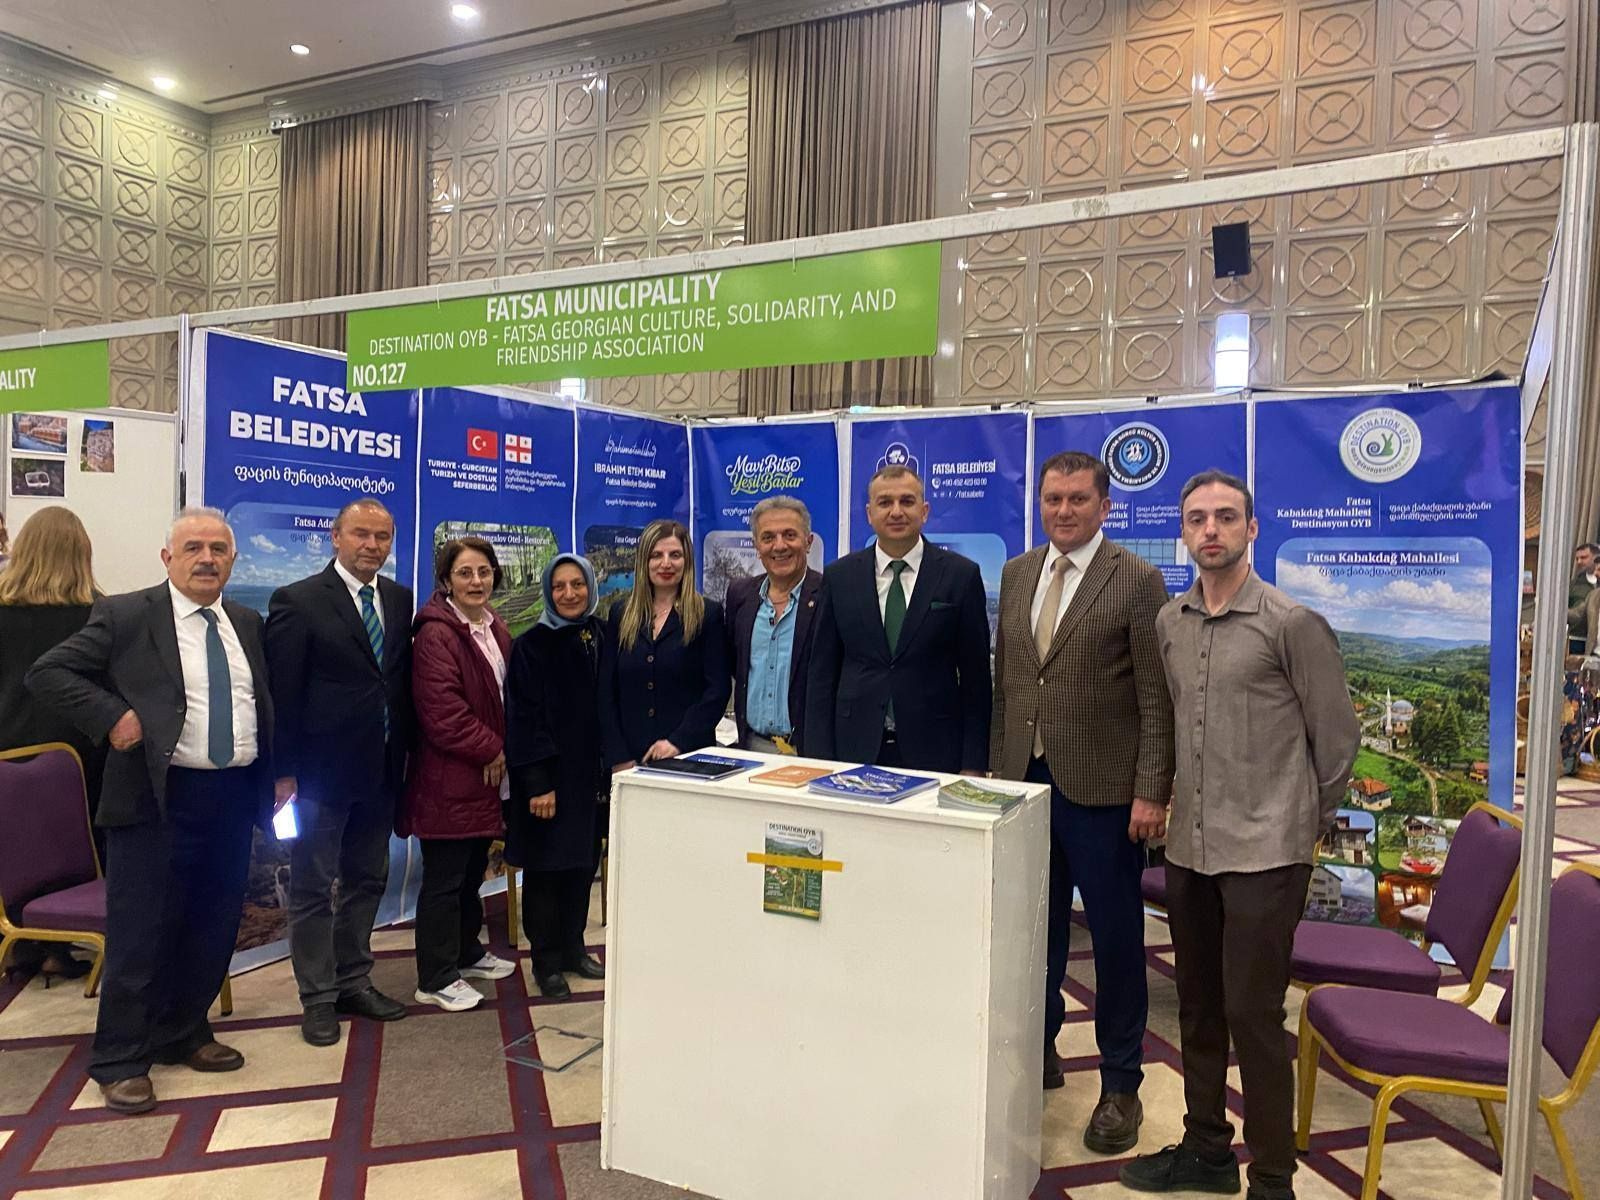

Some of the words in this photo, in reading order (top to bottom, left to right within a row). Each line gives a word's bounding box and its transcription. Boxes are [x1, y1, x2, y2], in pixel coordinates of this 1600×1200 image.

[486, 292, 548, 323] FATSA
[554, 272, 722, 316] MUNICIPALITY
[370, 332, 454, 356] DESTINATION
[459, 329, 487, 348] OYB
[503, 323, 546, 346] FATSA
[551, 316, 633, 341] GEORGIAN
[639, 307, 721, 333] CULTURE,
[727, 293, 844, 325] SOLIDARITY,
[850, 288, 897, 314] AND
[496, 342, 587, 367] FRIENDSHIP
[592, 333, 704, 360] ASSOCIATION
[352, 362, 407, 387] NO.127
[273, 376, 368, 417] FATSA
[725, 454, 765, 478] Mavi
[765, 454, 801, 474] Bitse
[932, 463, 955, 475] FATSA
[234, 465, 281, 484] ფაცის
[283, 467, 395, 495] მუნიციპალიტეტი
[457, 472, 467, 480] VE
[468, 473, 497, 483] DOSTLUK
[1346, 497, 1371, 506] Fatsa
[1325, 507, 1371, 517] Mahallesi
[294, 516, 316, 528] Fatsa
[1292, 519, 1348, 530] Destinasyon
[1350, 518, 1371, 528] OYB
[508, 535, 521, 544] Otel
[1306, 552, 1336, 563] Fatsa
[1338, 552, 1398, 566] Kabakdağ
[1400, 552, 1460, 563] Mahallesi
